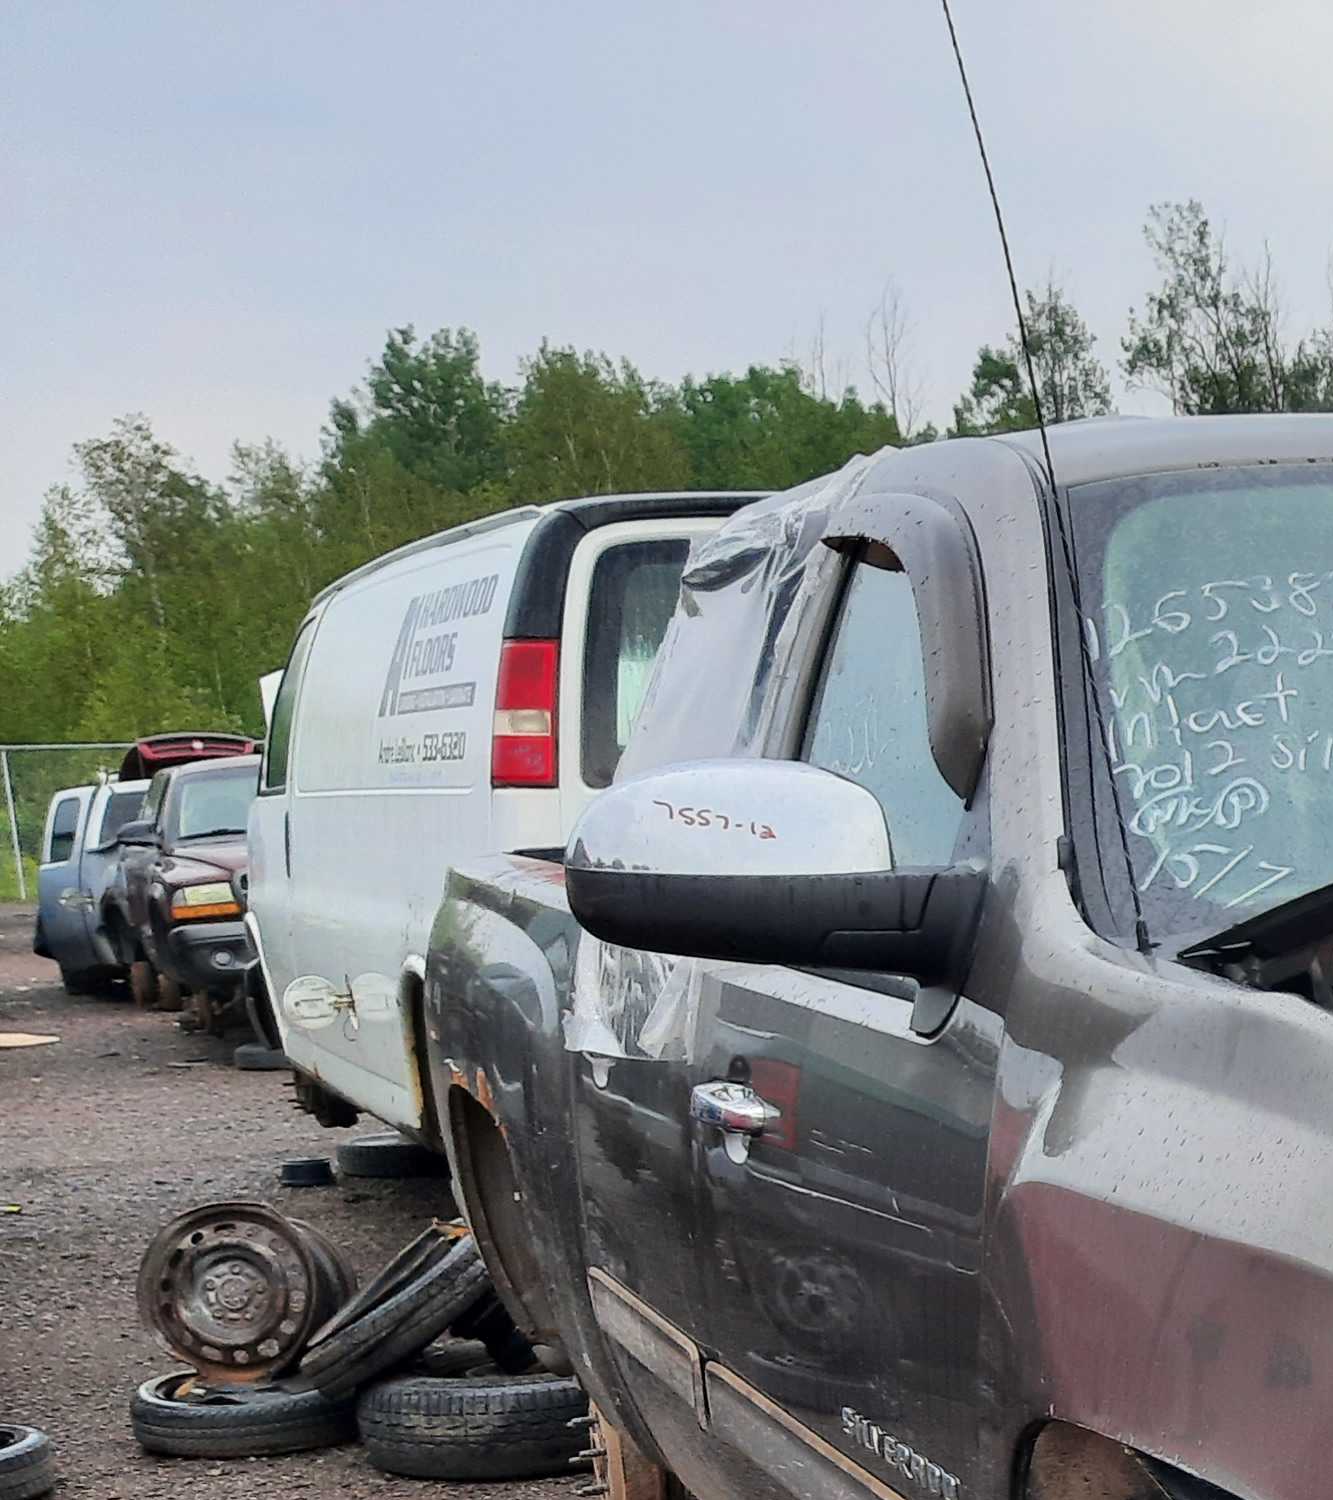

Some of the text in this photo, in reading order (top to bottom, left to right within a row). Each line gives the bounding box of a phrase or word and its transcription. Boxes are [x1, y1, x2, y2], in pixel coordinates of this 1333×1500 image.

[417, 573, 499, 630] HARDWOOD
[408, 631, 458, 679] FLOORS
[1111, 740, 1247, 800] 2012
[653, 799, 776, 840] 7557-12
